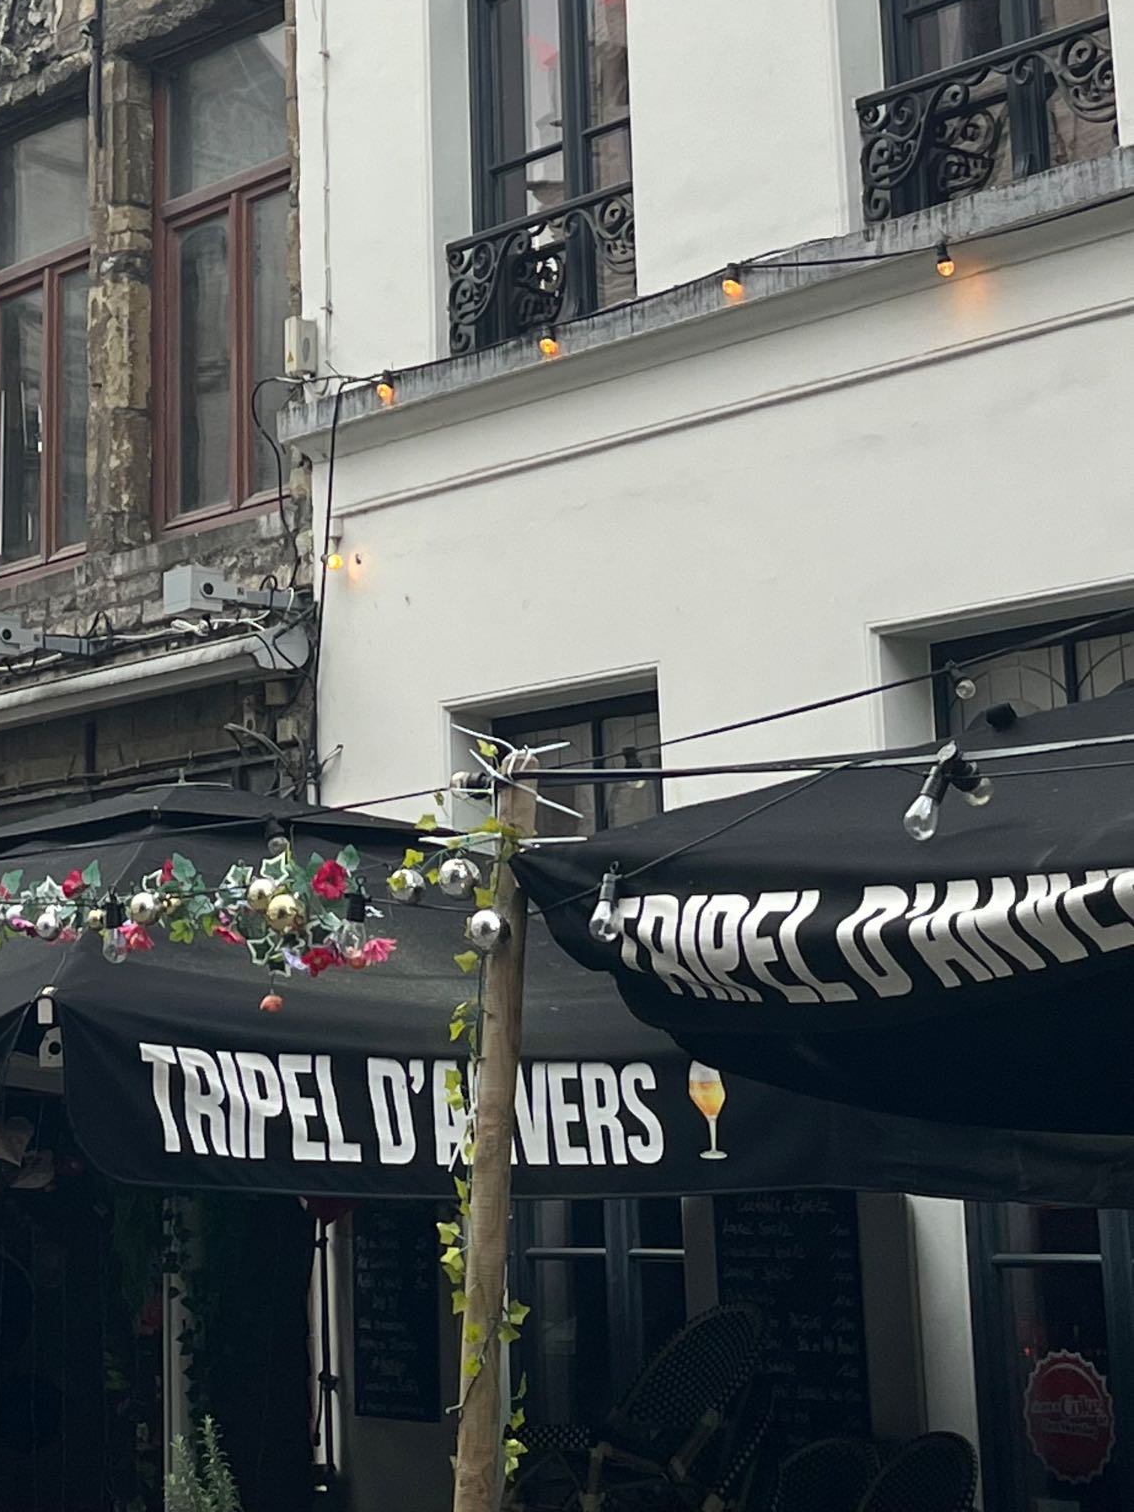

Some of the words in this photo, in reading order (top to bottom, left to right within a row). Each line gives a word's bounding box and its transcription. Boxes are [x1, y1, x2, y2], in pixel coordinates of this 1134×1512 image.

[617, 890, 858, 1003] TRIPEL
[836, 867, 1134, 998] D'ANVE
[139, 1042, 362, 1163] TRIPEL
[367, 1057, 664, 1165] D'AVERS
